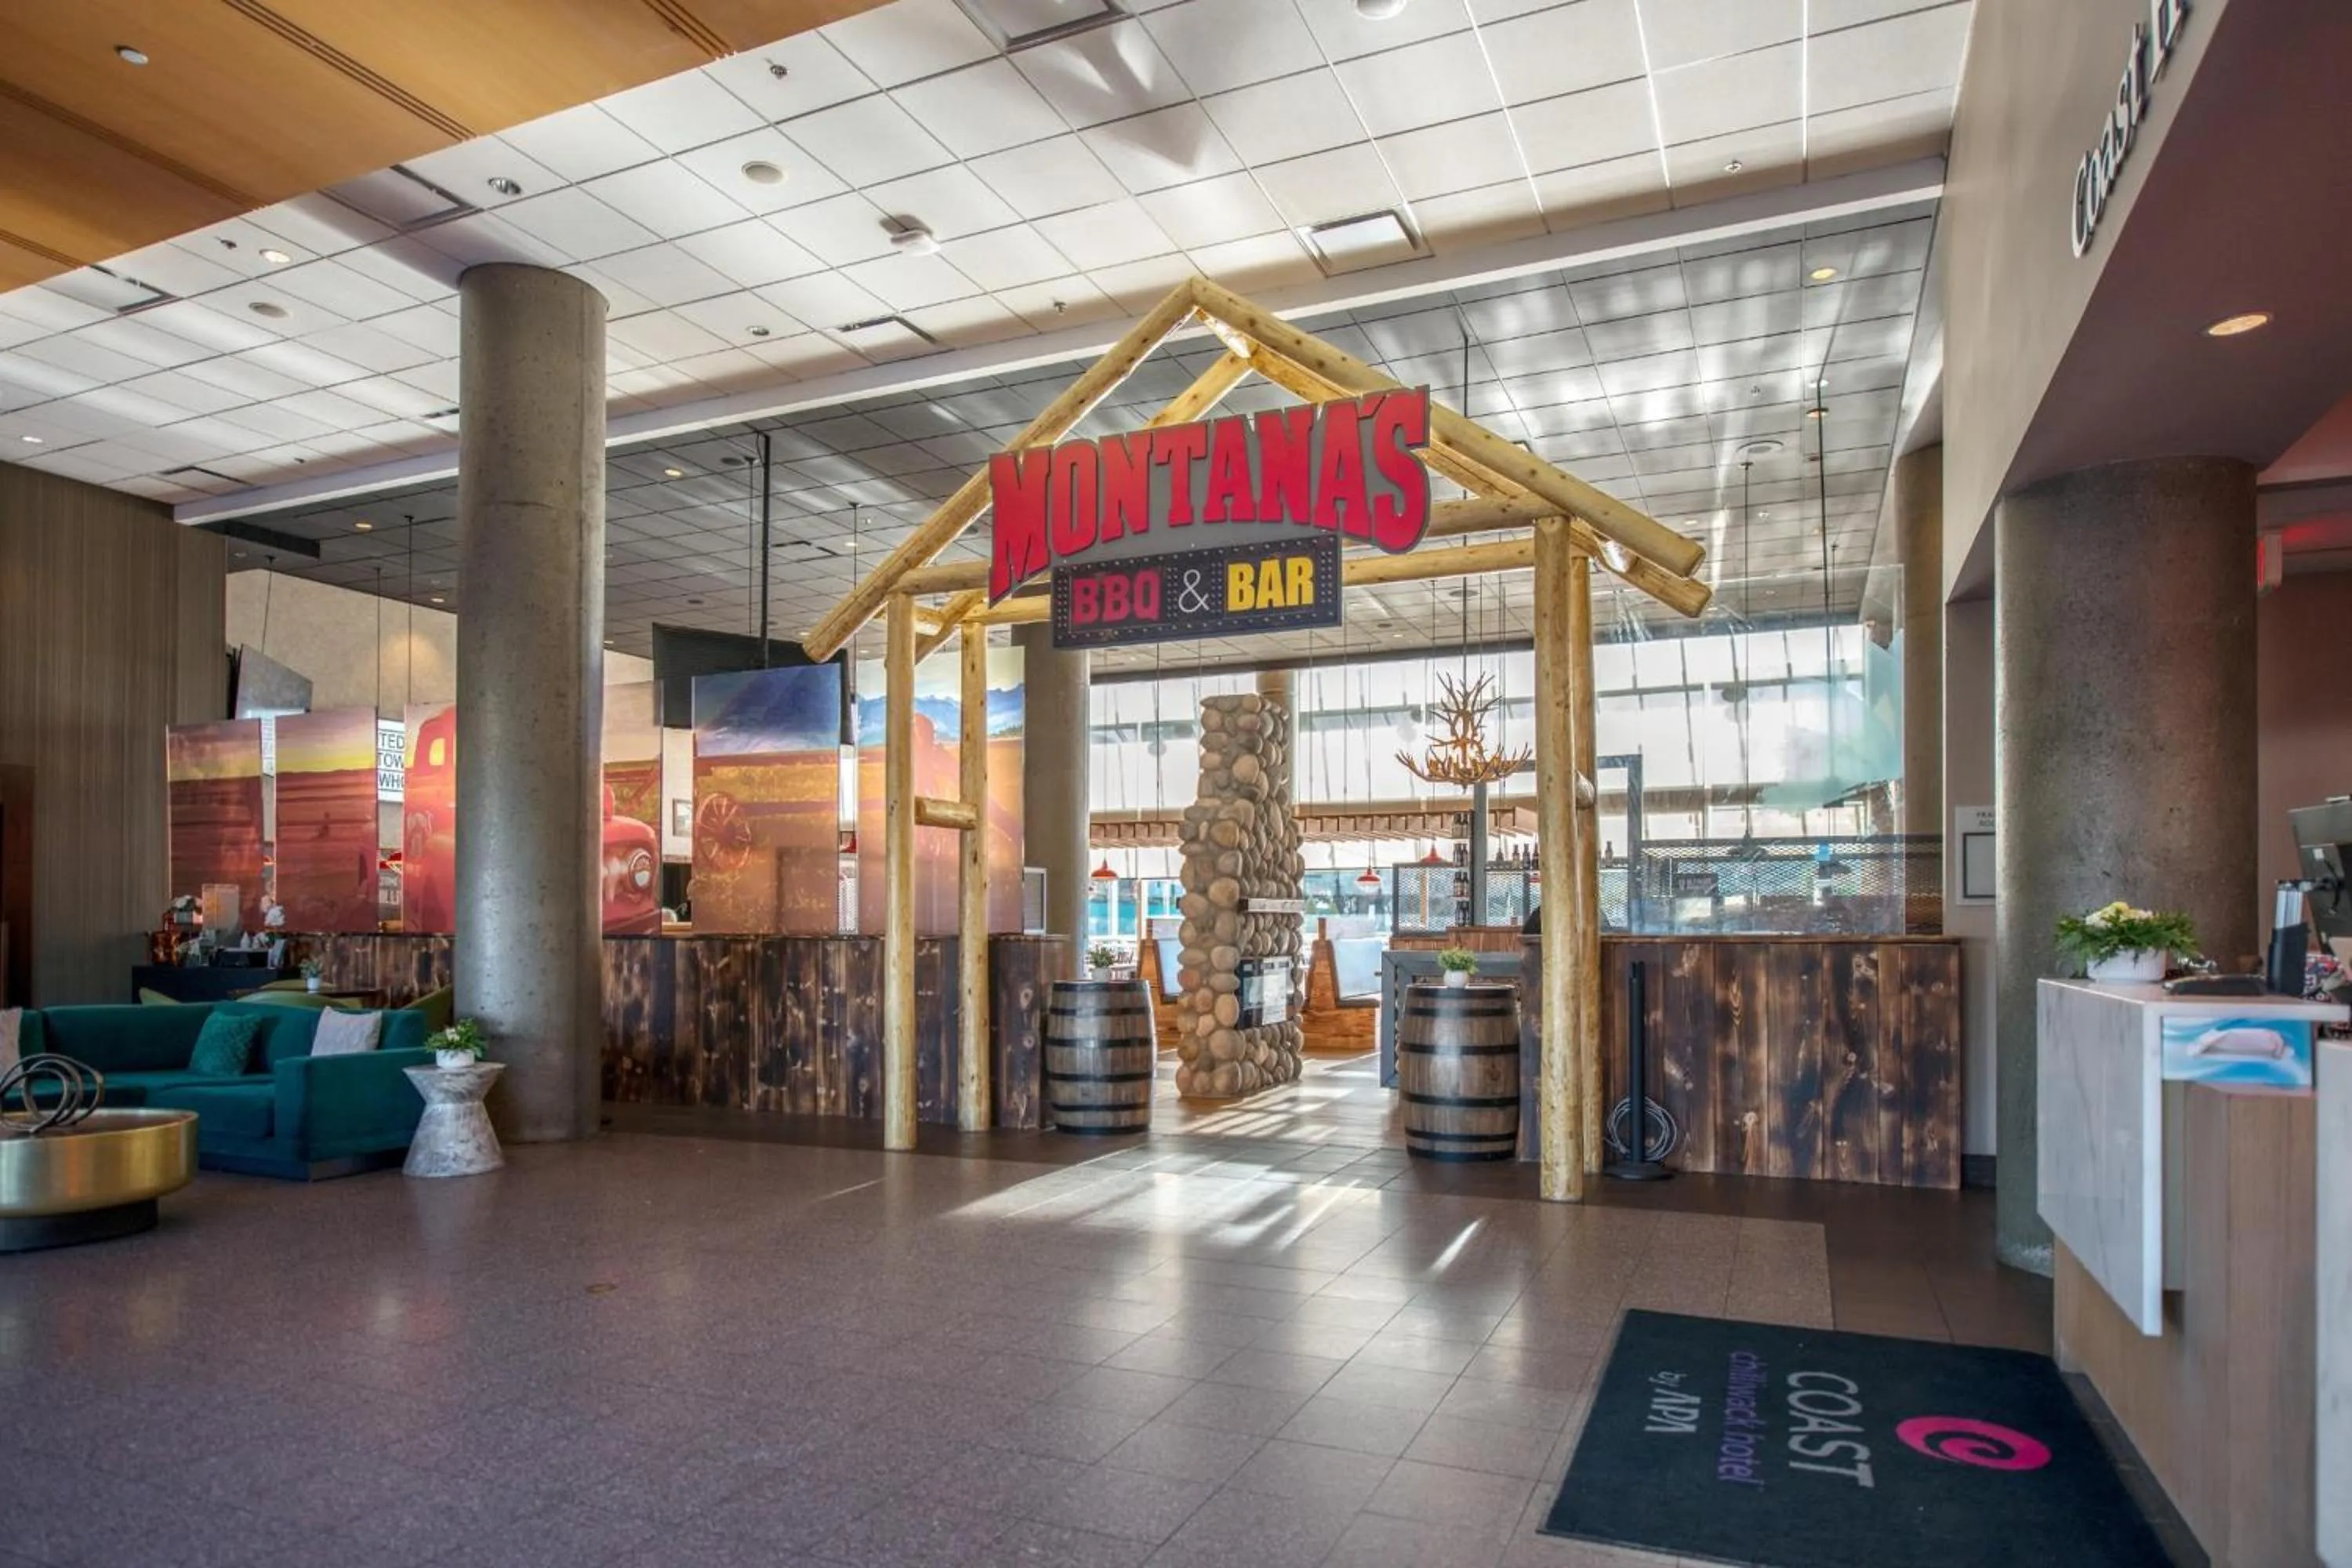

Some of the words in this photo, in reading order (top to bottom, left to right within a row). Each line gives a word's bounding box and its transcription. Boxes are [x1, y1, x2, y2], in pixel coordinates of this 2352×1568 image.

[2072, 22, 2142, 257] Coast
[989, 387, 1428, 601] MONTANA'S
[1071, 567, 1162, 624] BBQ
[1178, 569, 1210, 612] &
[1227, 557, 1315, 612] BAR
[1645, 1388, 1701, 1432] APA
[1648, 1371, 1687, 1387] by
[1725, 1351, 1768, 1428] chilliwack
[1719, 1431, 1765, 1485] hotel
[1787, 1371, 1875, 1488] COAST
